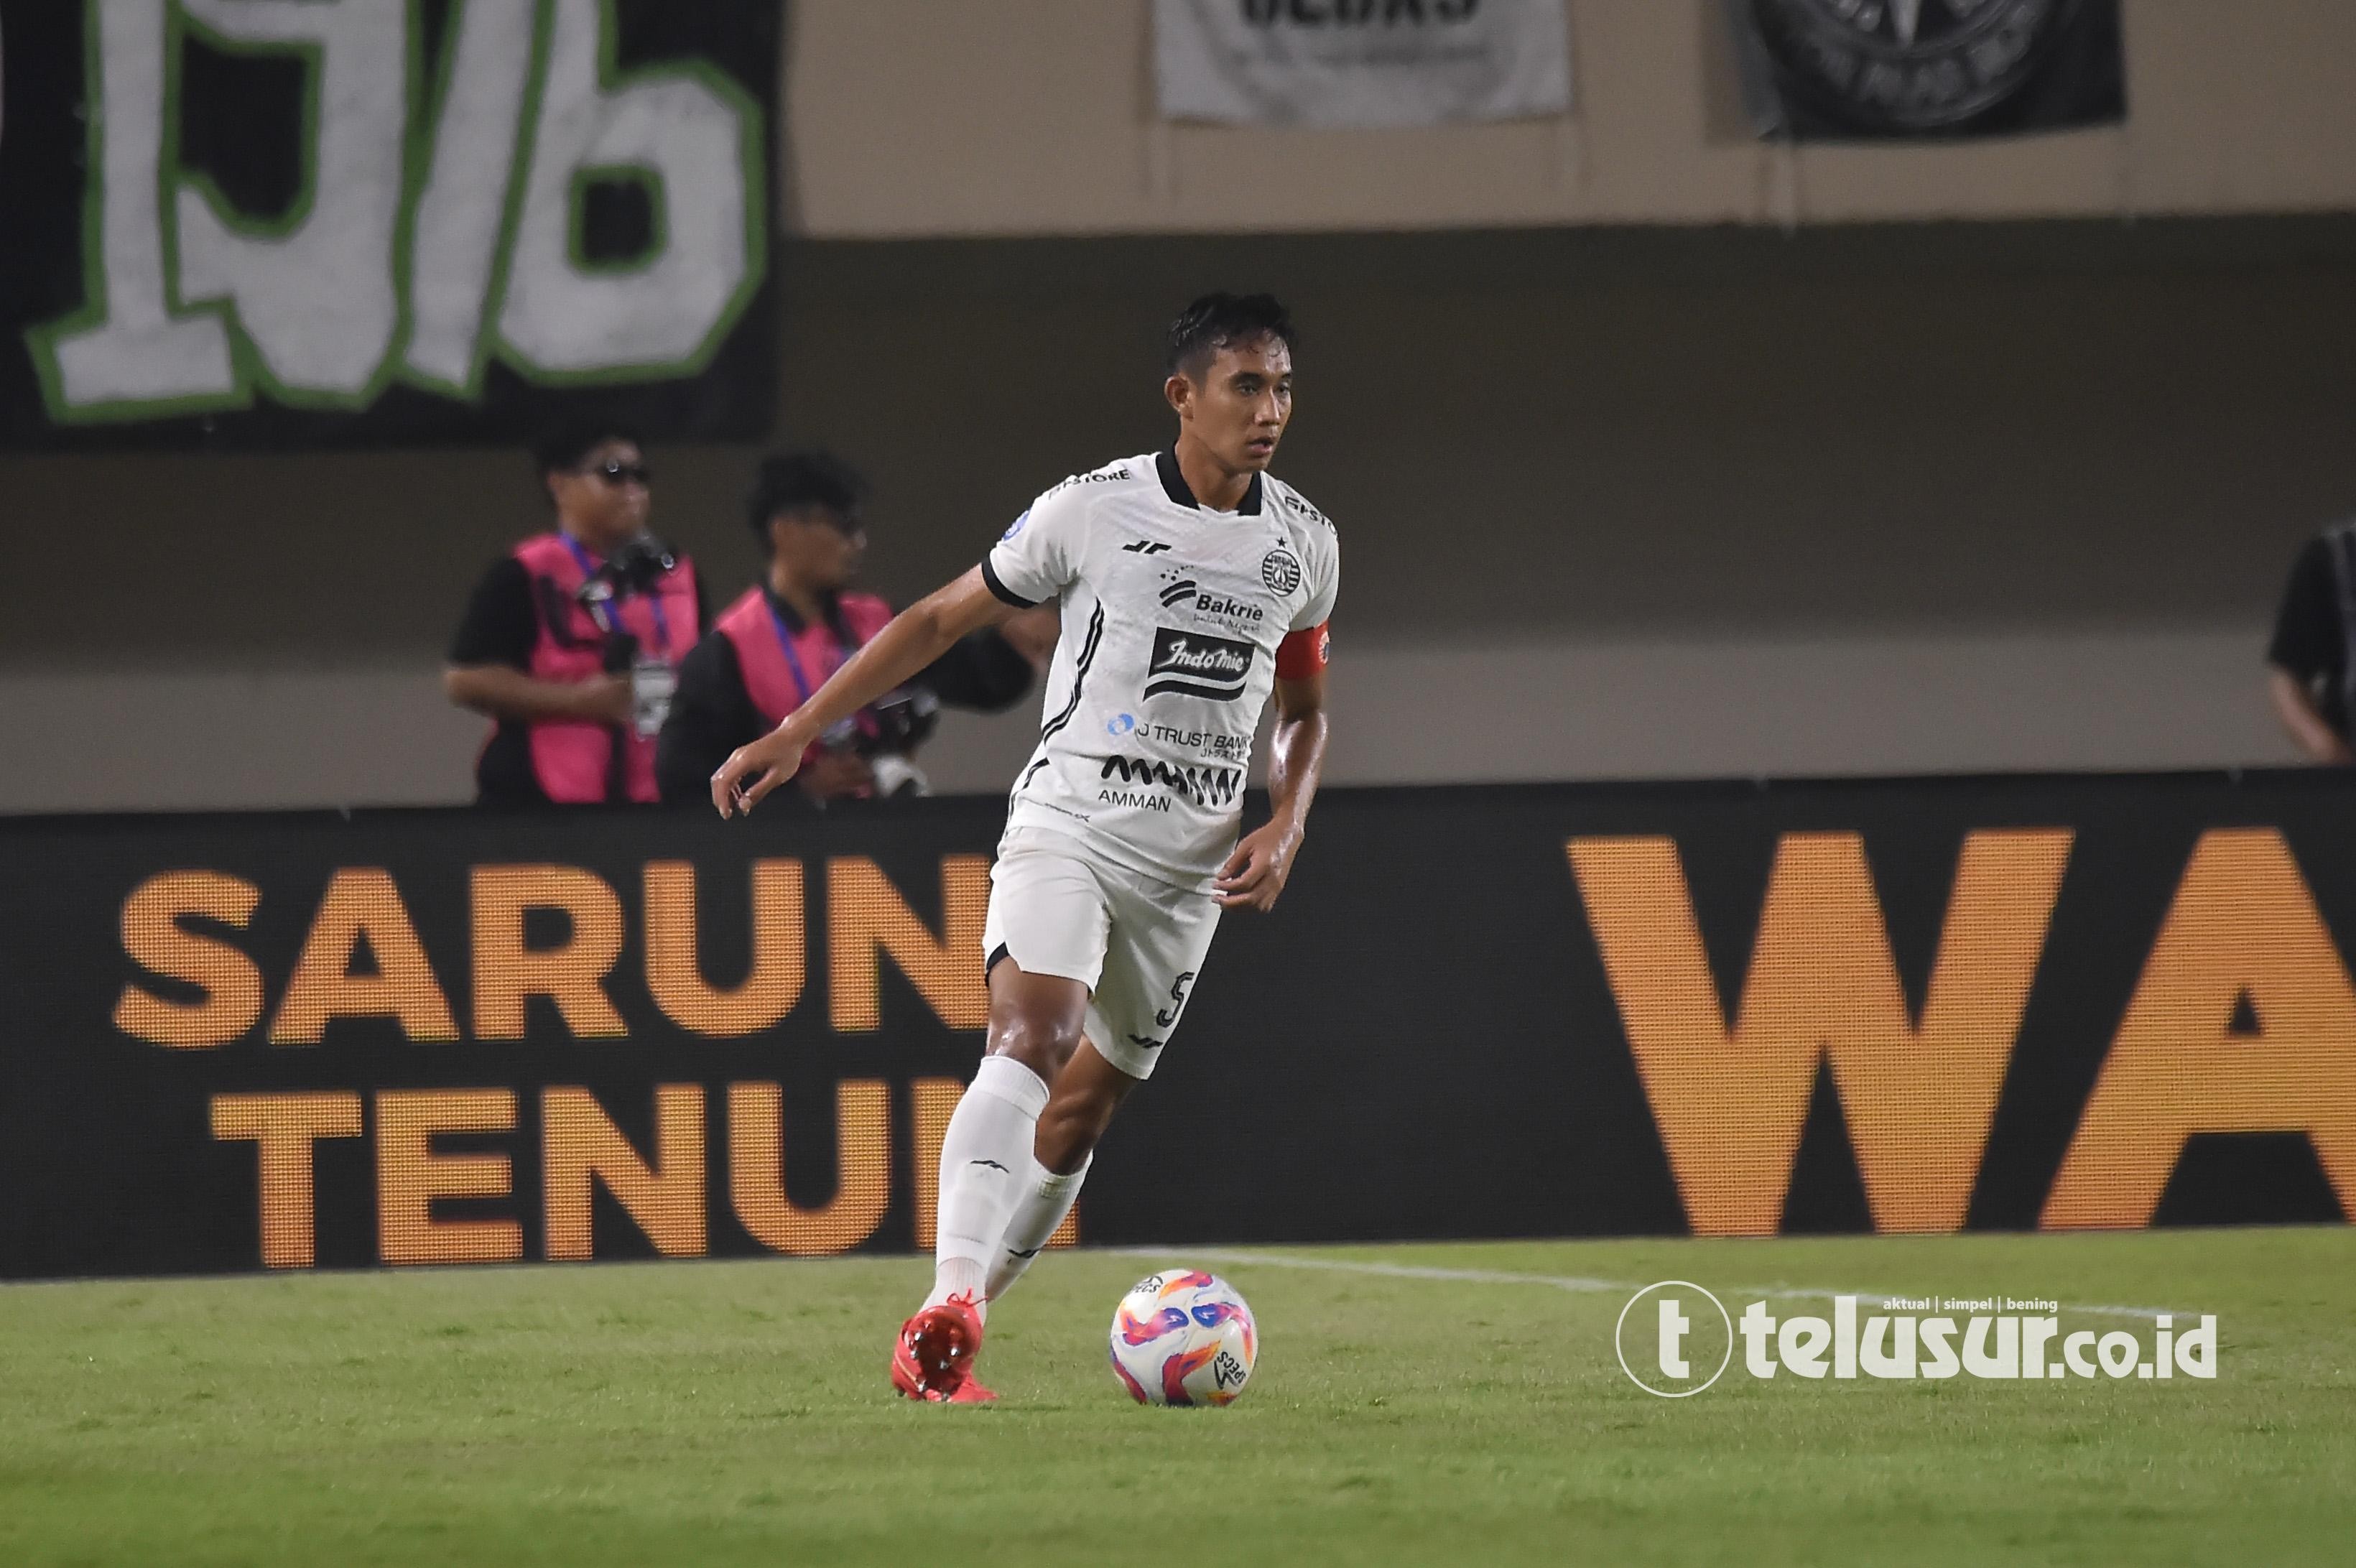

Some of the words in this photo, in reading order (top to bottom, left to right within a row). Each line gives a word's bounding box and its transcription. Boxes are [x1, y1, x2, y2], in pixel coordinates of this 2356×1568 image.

[1196, 594, 1263, 621] Bakrie
[1155, 637, 1245, 672] Indomie
[1138, 723, 1149, 736] J
[1154, 725, 1212, 747] TRUST
[1098, 789, 1171, 812] AMMAN
[1564, 827, 2356, 1238] WA
[1216, 1351, 1247, 1384] SPECS
